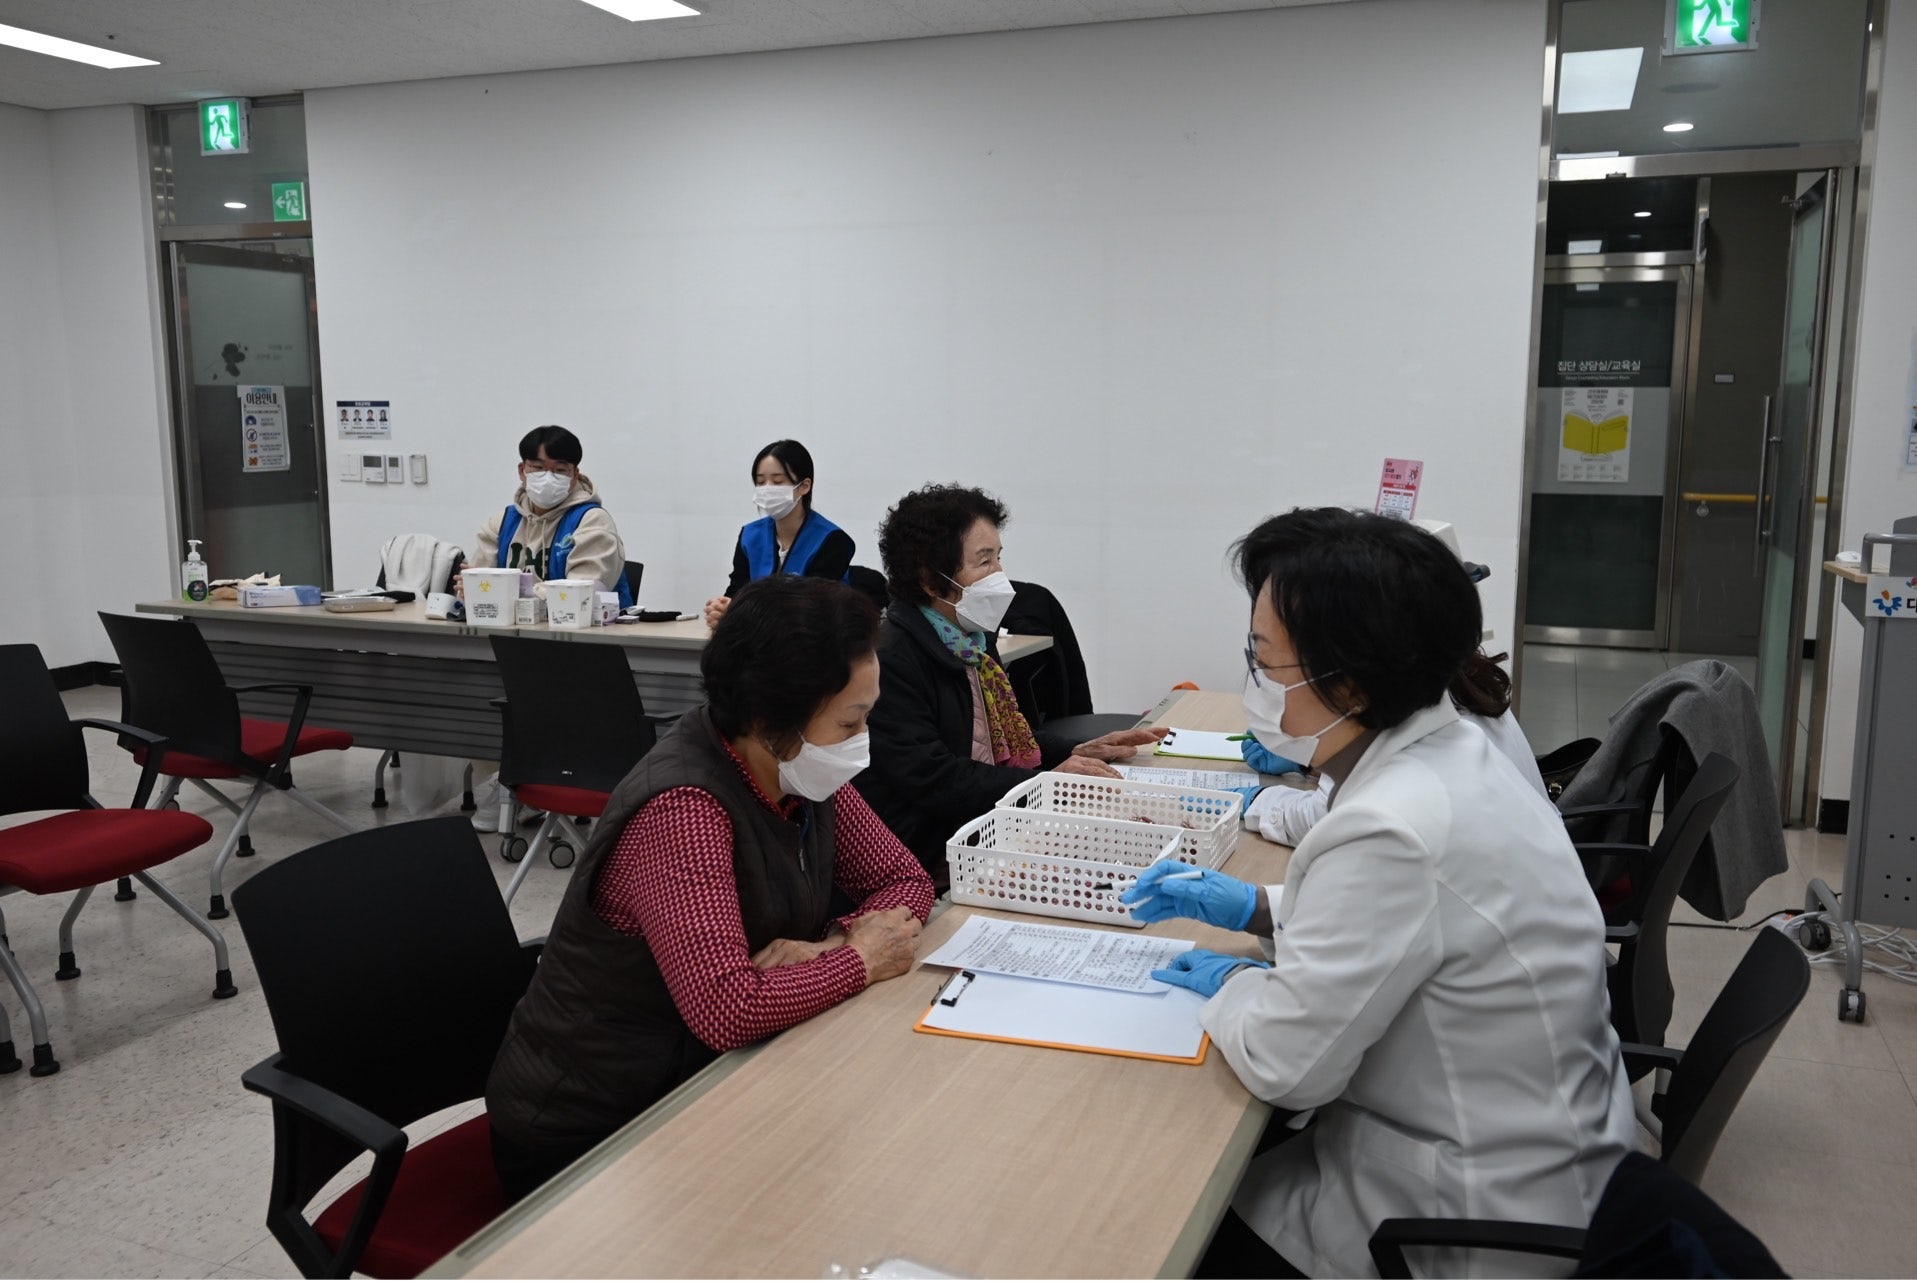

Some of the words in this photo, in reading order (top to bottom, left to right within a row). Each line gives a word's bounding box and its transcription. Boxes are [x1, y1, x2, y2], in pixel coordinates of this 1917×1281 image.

[1558, 360, 1576, 372] 집단
[1579, 360, 1641, 372] 상담실/교육실
[246, 392, 278, 405] 이용안내
